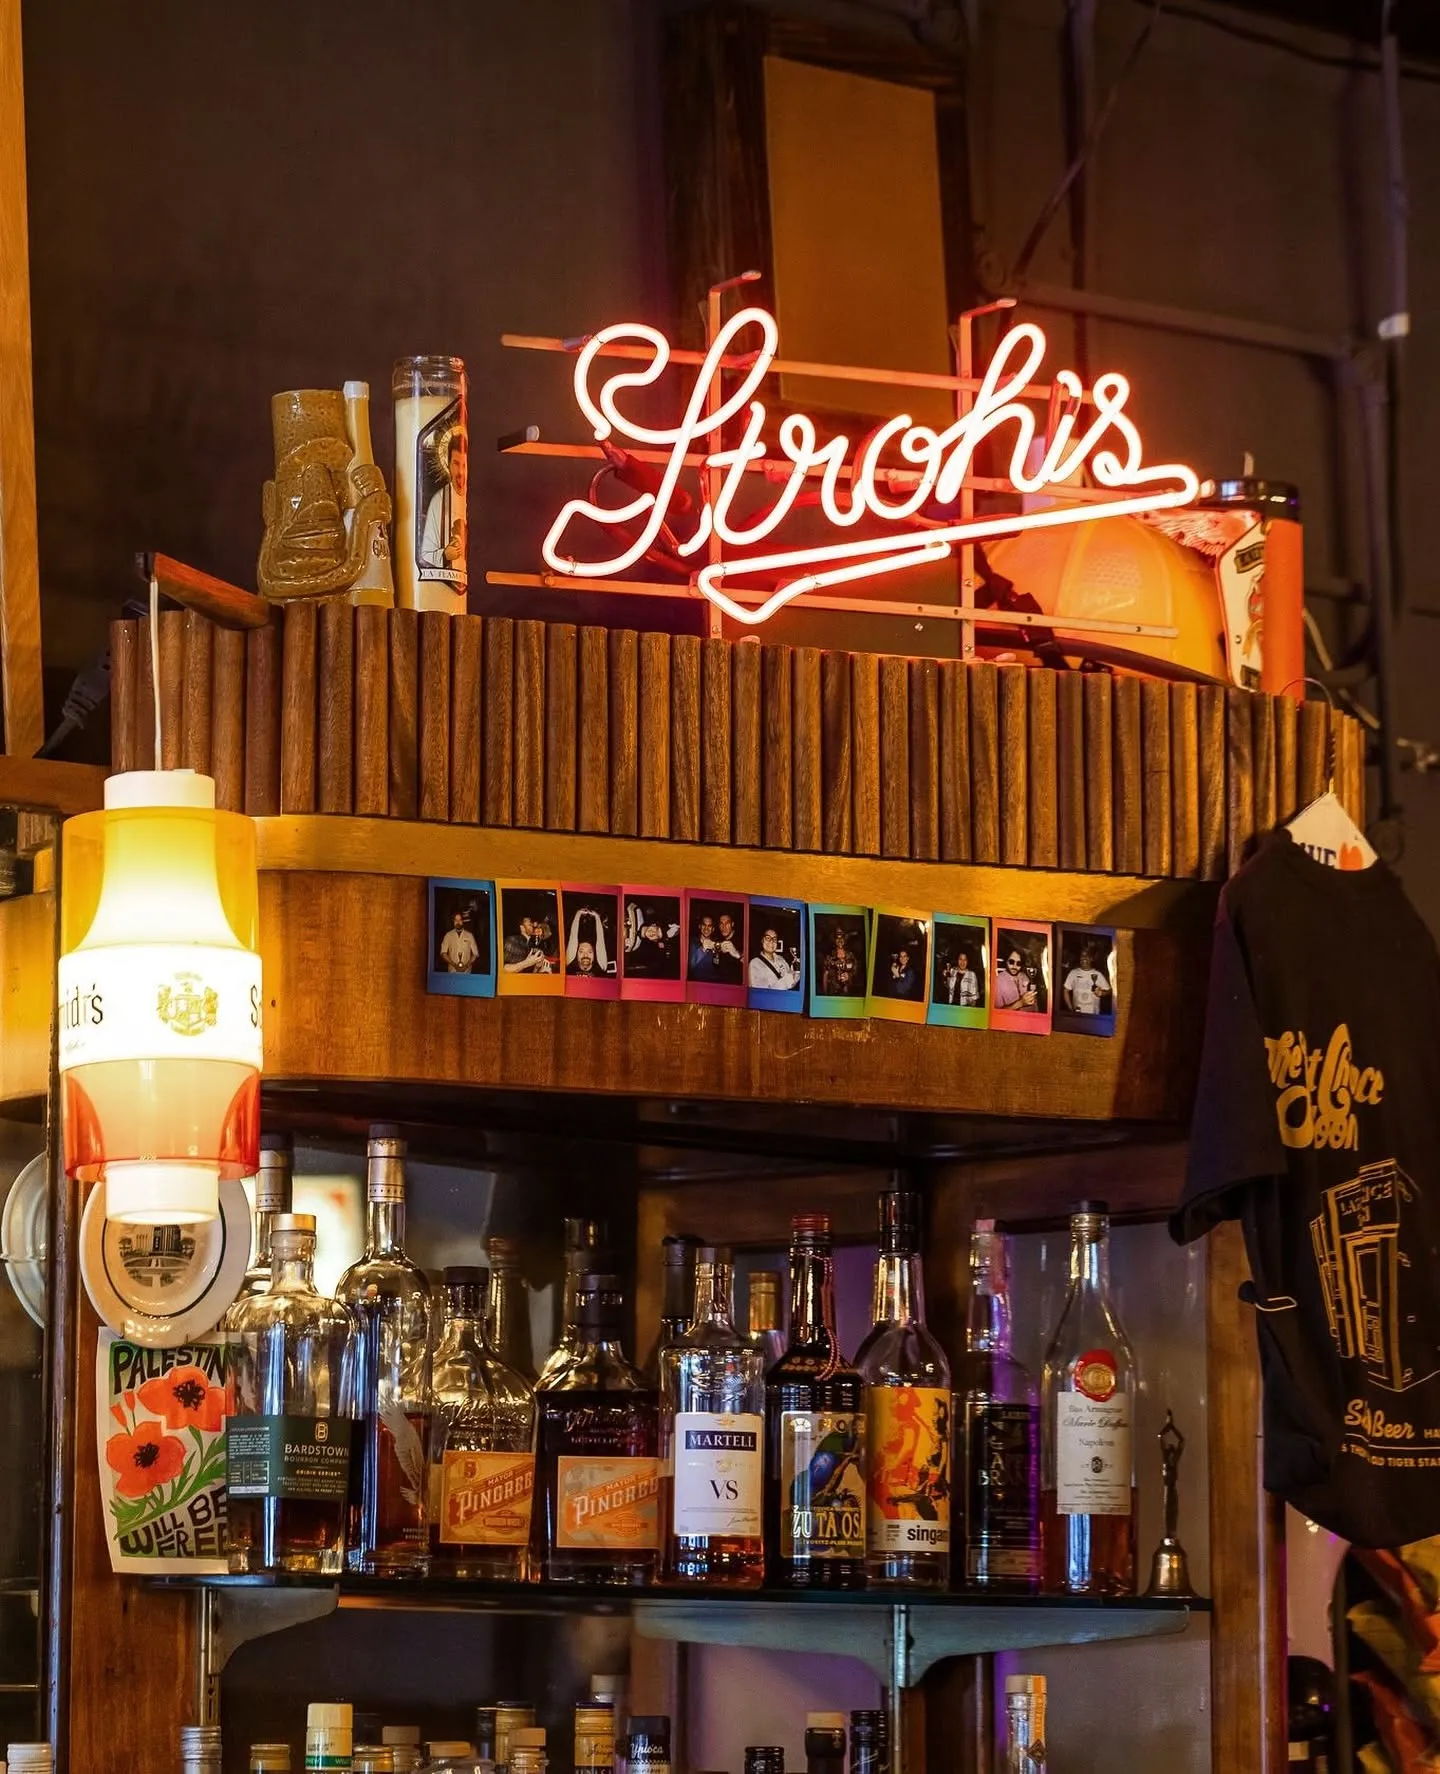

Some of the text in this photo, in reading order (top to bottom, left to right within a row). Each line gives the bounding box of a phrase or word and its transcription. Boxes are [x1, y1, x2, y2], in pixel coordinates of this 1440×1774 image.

[542, 307, 1200, 578] Stroh's
[250, 985, 263, 1028] S
[113, 1345, 226, 1395] PALESTIN
[689, 1434, 754, 1448] MARTELL
[710, 1479, 739, 1501] VS
[121, 1512, 185, 1554] WILL
